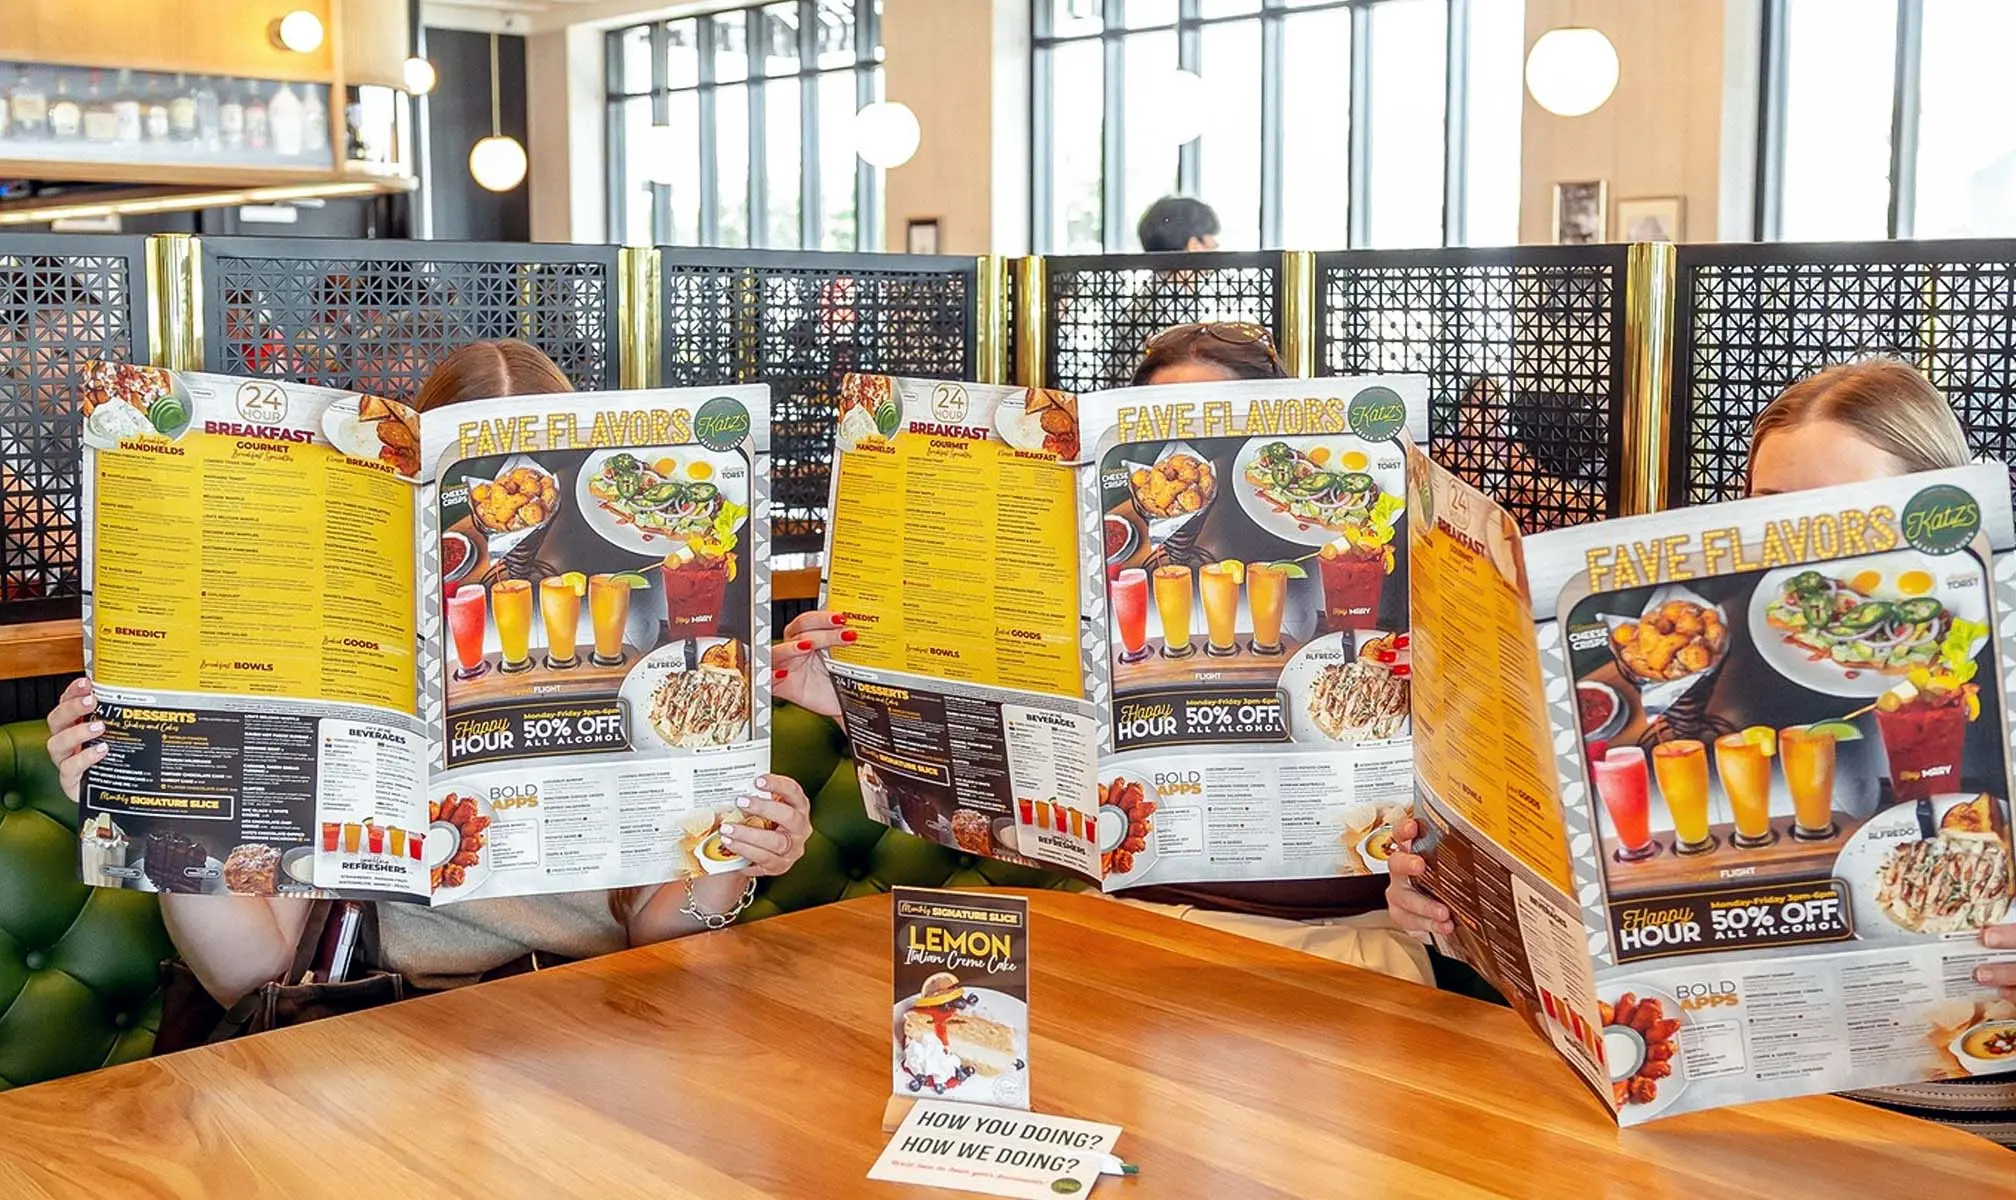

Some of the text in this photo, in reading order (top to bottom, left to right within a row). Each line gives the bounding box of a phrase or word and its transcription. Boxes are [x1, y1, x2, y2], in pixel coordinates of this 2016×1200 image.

[245, 386, 282, 411] 24
[937, 389, 965, 411] 24
[243, 408, 281, 422] HOUR
[1117, 396, 1347, 444] FAVE FLAVORS
[204, 420, 315, 444] BREAKFAST
[458, 407, 692, 459] FAVE FLAVORS
[909, 420, 990, 441] BREAKFAST
[120, 441, 185, 456] HANDHELDS
[236, 441, 290, 453] GOURMET
[930, 440, 969, 451] GOURMET
[1014, 451, 1057, 462] BREAKFAST
[346, 457, 395, 474] BREAKFAST
[1450, 485, 1467, 515] 24
[1437, 516, 1486, 558] BREAKFAST
[1585, 504, 1899, 593] FAVE FLAVORS
[115, 627, 167, 639] BENEDICT
[1011, 629, 1042, 641] GOODS
[1569, 627, 1608, 642] CHEESE
[344, 638, 379, 650] GOODS
[1572, 636, 1608, 651] CRISPS
[930, 647, 960, 659] BOWLS
[234, 661, 274, 672] BOWLS
[1195, 672, 1222, 680] FLIGHT
[533, 684, 561, 694] FLIGHT
[122, 708, 197, 723] DESSERTS
[1026, 713, 1076, 729] BEVERAGES
[1120, 703, 1174, 724] Happy
[1186, 705, 1280, 725] 50% OFF
[454, 717, 511, 741] Happy
[523, 714, 622, 739] 50% OFF
[1118, 717, 1177, 741] HOUR
[1219, 724, 1282, 733] ALCOHOL
[349, 728, 406, 745] BEVERAGES
[451, 731, 514, 757] HOUR
[525, 733, 622, 747] ALL ALCOHOL
[1155, 770, 1200, 785] BOLD
[490, 783, 538, 800] BOLD
[1156, 783, 1202, 796] APPS
[130, 796, 188, 808] SIGNATURE
[189, 800, 219, 809] SLICE
[491, 795, 539, 811] APPS
[342, 861, 407, 874] REFRESHERS
[1720, 867, 1756, 878] FLIGHT
[1710, 890, 1837, 909] Monday-Friday 3pm-6pm
[932, 907, 988, 921] SIGNATURE
[988, 913, 1018, 924] SLICE
[1622, 904, 1695, 933] Happy
[1710, 898, 1839, 930] 50% OFF
[1620, 922, 1702, 950] HOUR
[1715, 922, 1841, 940] ALL ALCOHOL
[909, 925, 1011, 958] LEMON
[904, 945, 1017, 974] Italian Creme Cake
[1676, 980, 1736, 999] BOLD
[1679, 994, 1739, 1013] APPS
[917, 1110, 1104, 1150] HOW YOU DOING?
[900, 1136, 1081, 1174] HOW WE DOING?
